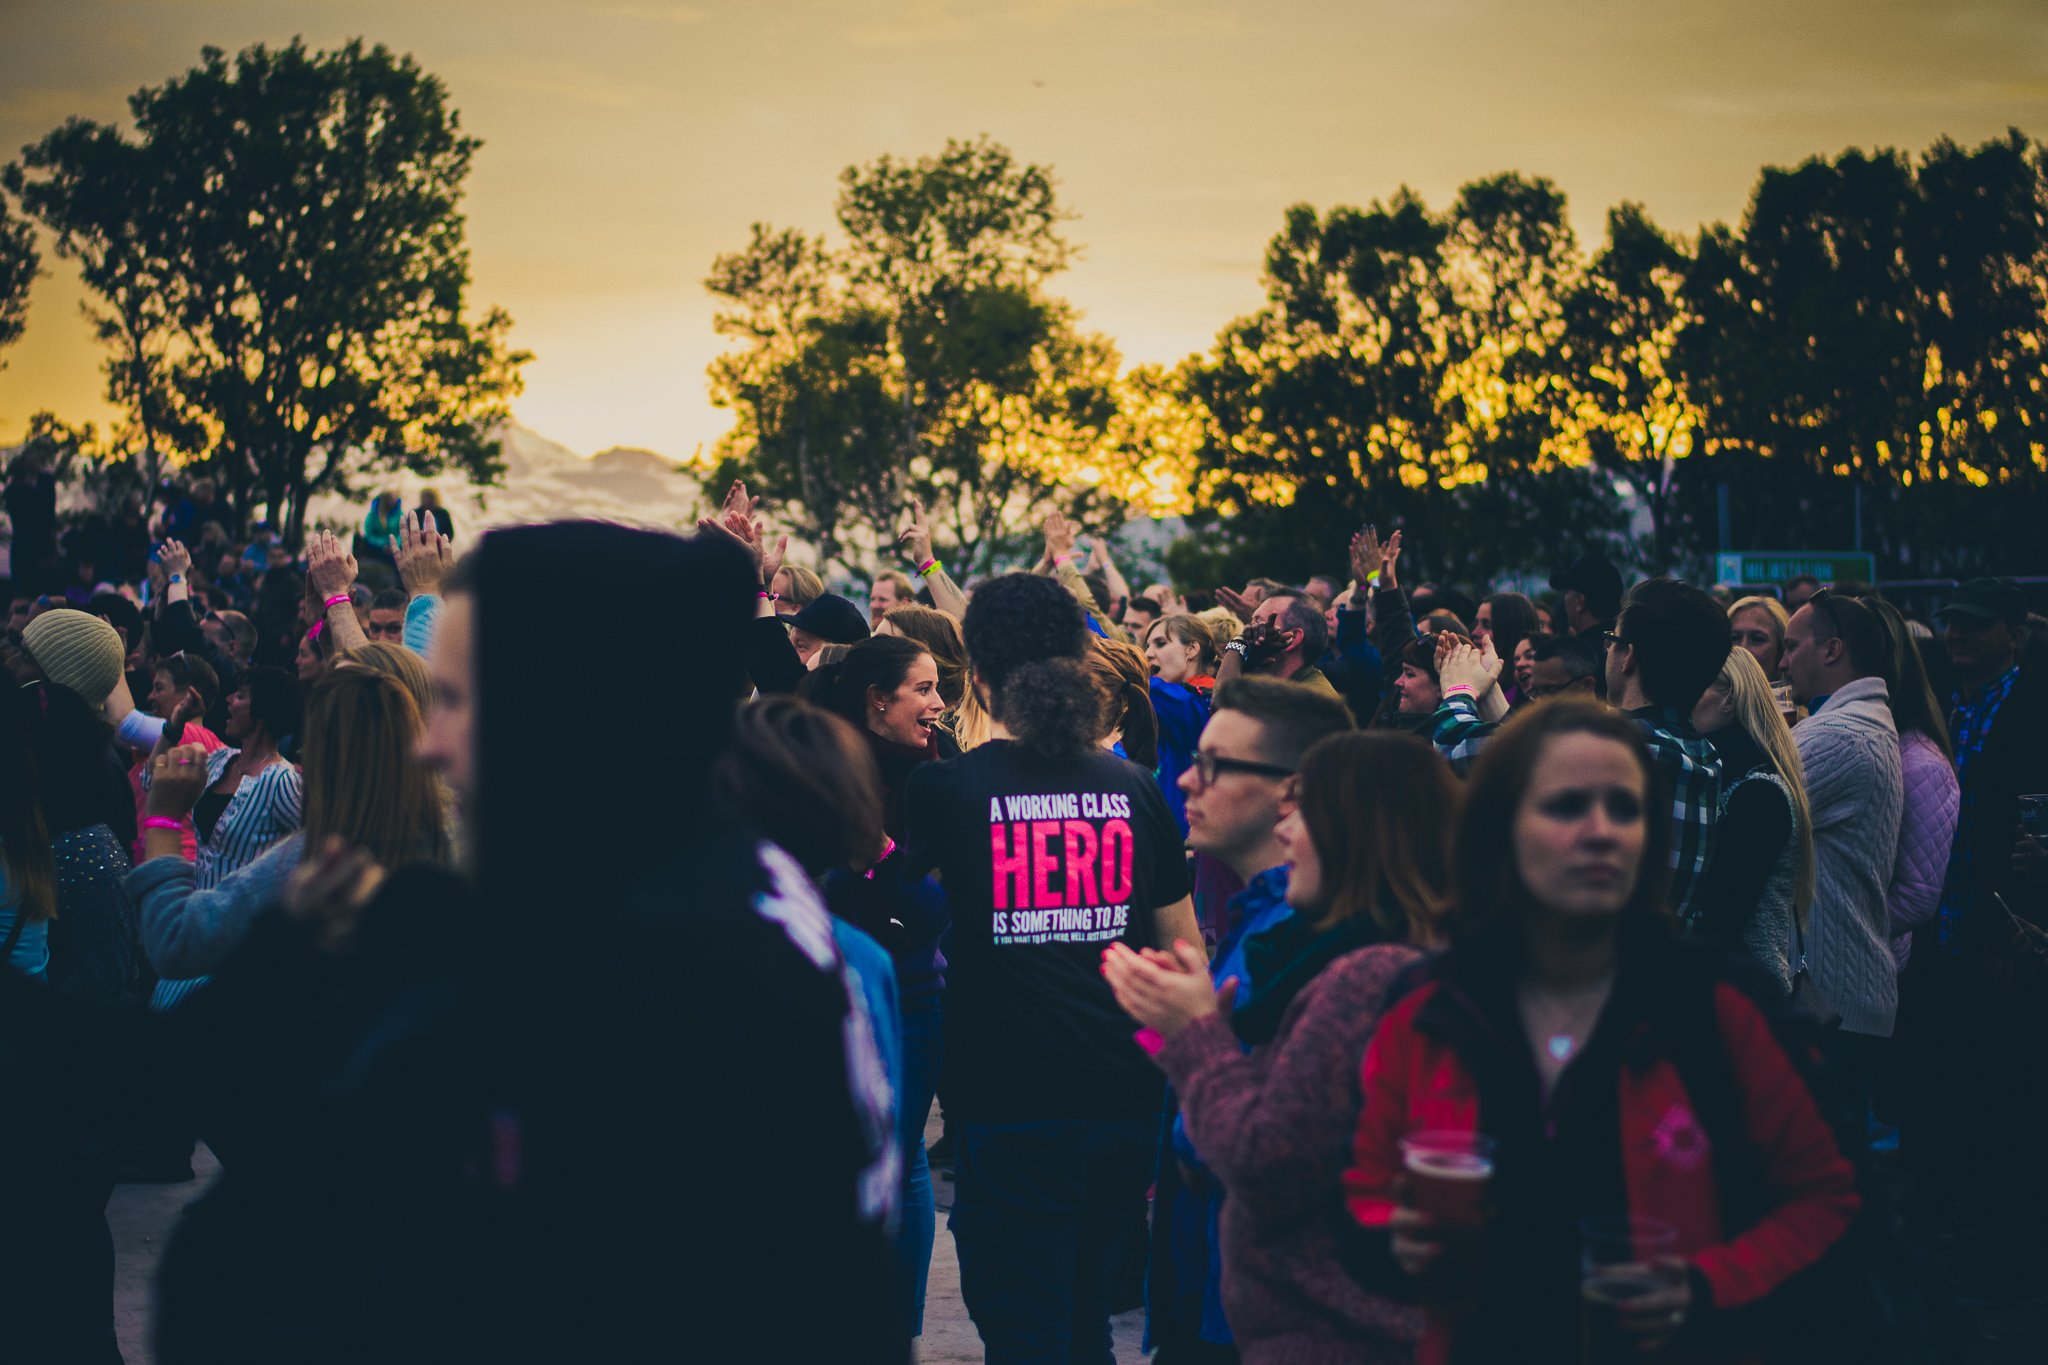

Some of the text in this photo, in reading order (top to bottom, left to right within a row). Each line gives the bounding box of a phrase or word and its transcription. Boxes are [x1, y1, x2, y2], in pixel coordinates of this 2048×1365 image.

[990, 792, 1131, 822] A WORKING CLASS
[990, 818, 1133, 910] HERO
[993, 905, 1130, 934] IS SOMETHING TO BE
[1000, 935, 1012, 945] YOU
[1032, 934, 1040, 944] TO
